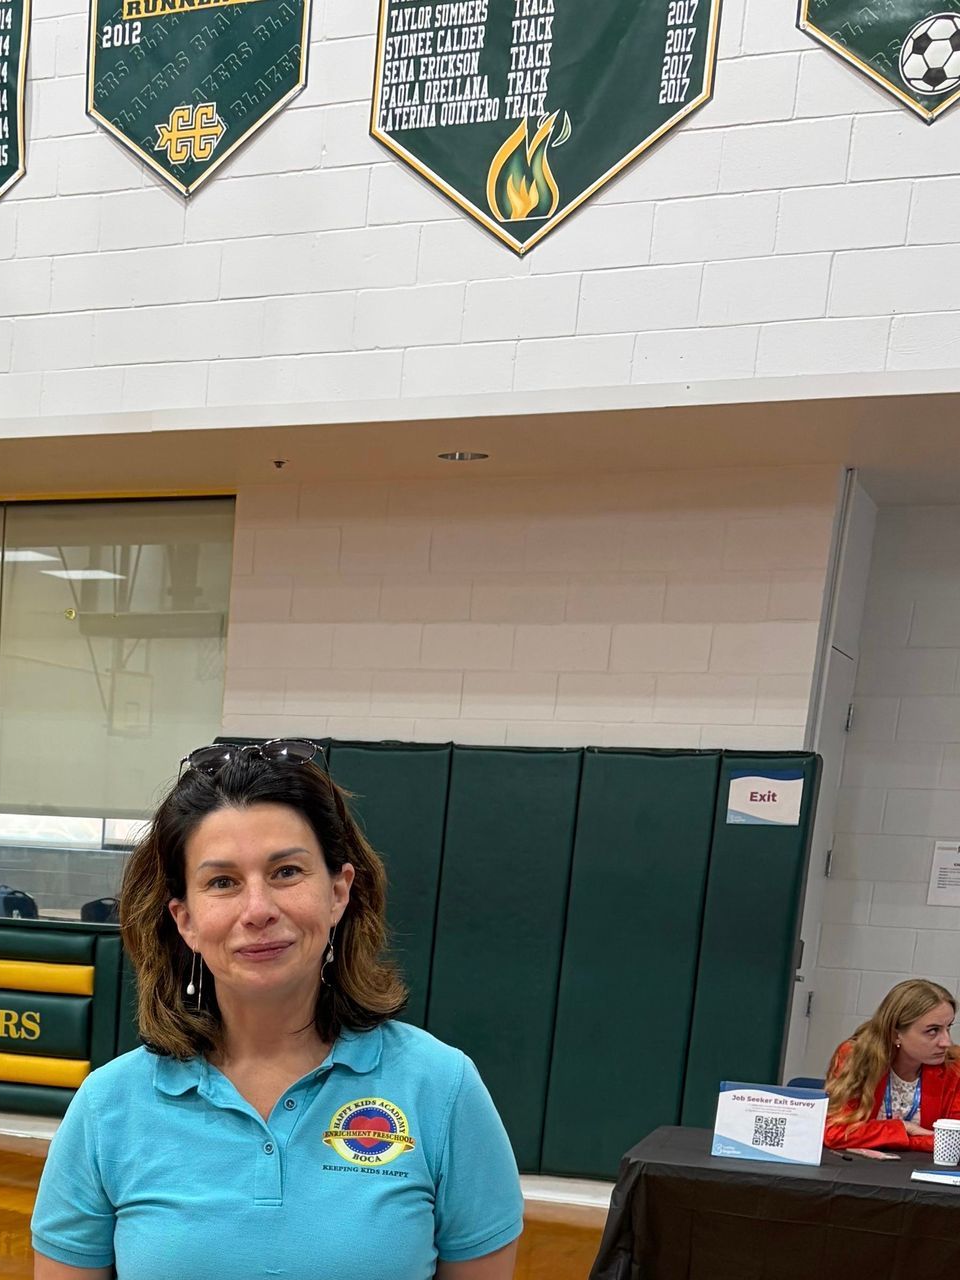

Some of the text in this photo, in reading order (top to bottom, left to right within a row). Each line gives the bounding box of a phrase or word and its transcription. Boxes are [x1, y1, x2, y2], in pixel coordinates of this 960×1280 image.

[386, 0, 698, 60] SYDNEE CALDER TRACK 2017
[391, 0, 555, 32] TAYLOR SUMMERS TRACK
[102, 21, 142, 48] 2012
[383, 28, 696, 85] SENA ERICKSON TRACK 2017
[381, 54, 693, 108] PAOLA ORELLANA TRACK 2017
[379, 78, 690, 132] CATERINA QUINTERO TRACK 2017
[750, 790, 777, 802] Exit
[334, 1100, 406, 1133] HAPPY KIDS ACADEMY
[747, 1096, 772, 1104] Seeker
[790, 1100, 815, 1108] Survey
[373, 1131, 413, 1144] PRESCHOOL
[352, 1154, 382, 1162] BOCA
[382, 1168, 409, 1178] HAPPY
